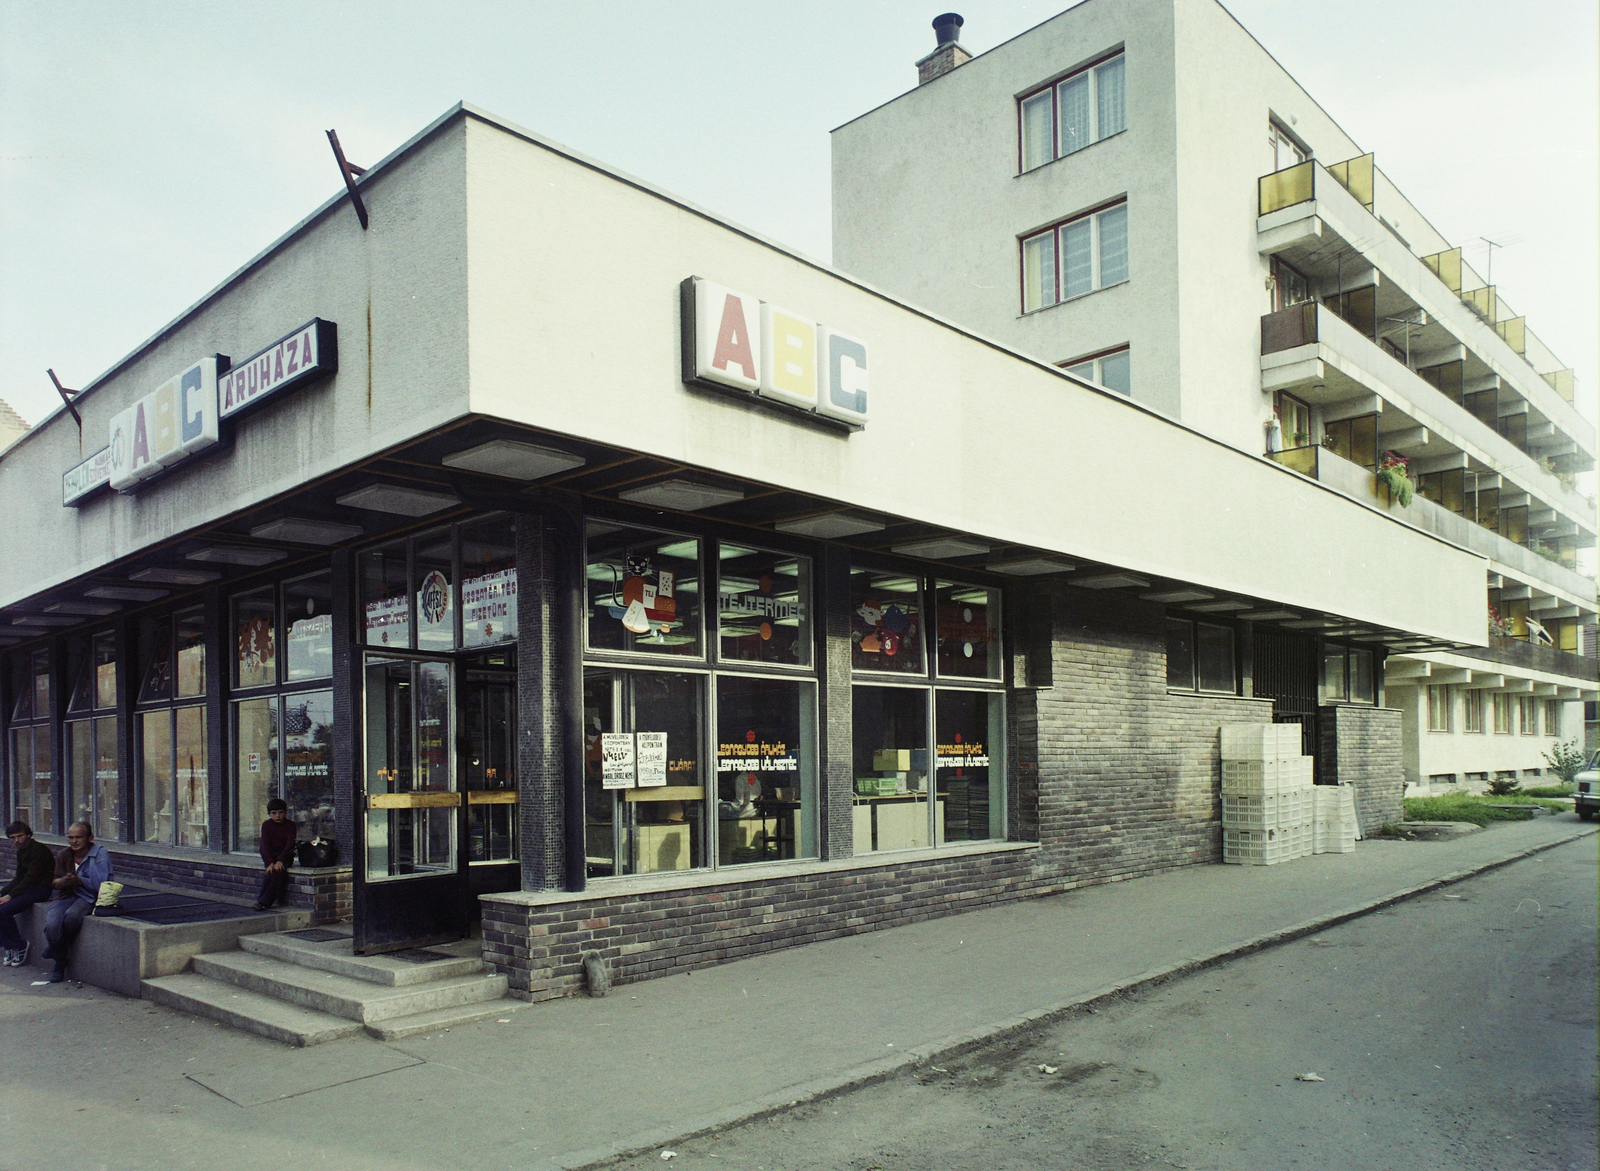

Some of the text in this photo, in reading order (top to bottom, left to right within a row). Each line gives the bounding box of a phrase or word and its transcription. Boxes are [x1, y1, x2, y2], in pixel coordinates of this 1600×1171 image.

[712, 293, 867, 414] ABC
[132, 365, 203, 470] ABC
[645, 590, 654, 598] TEJ
[717, 758, 760, 772] LEGNAGYOBB
